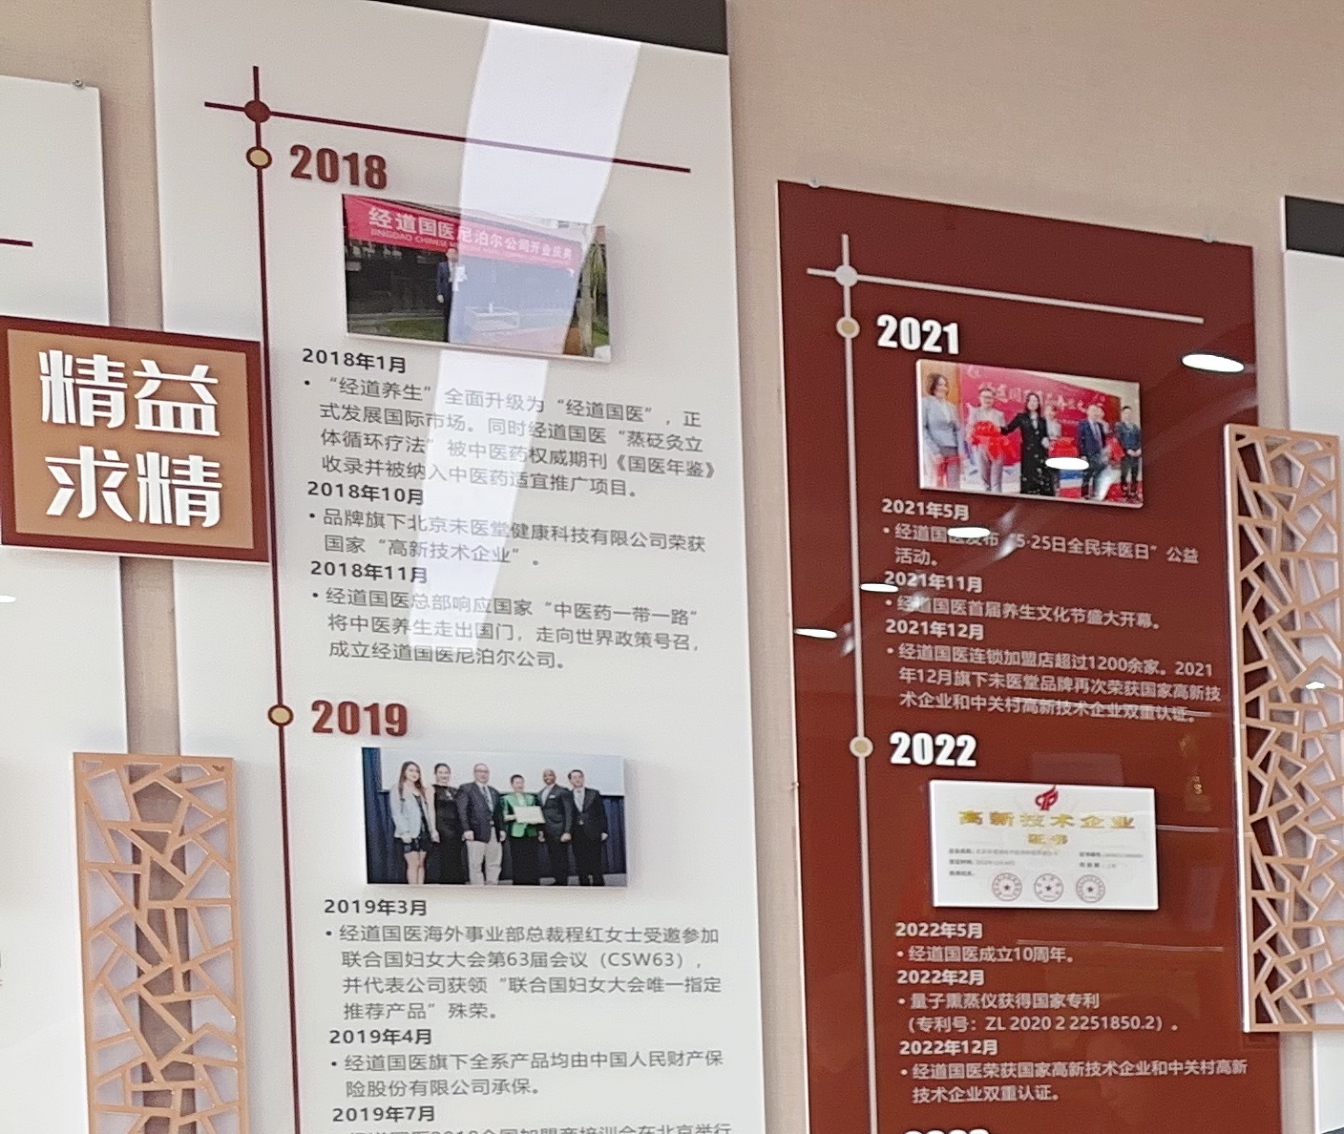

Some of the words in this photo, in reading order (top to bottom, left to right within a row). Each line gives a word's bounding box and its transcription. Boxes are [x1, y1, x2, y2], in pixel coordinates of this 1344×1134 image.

[289, 144, 388, 190] 2018
[876, 314, 960, 355] 2021
[302, 348, 406, 373] 2018年1月
[39, 349, 221, 437] 精益
[45, 446, 223, 528] 求精
[307, 481, 424, 505] 2018年10月
[882, 499, 970, 521] 2021年5月
[895, 547, 938, 567] 活动。
[310, 560, 428, 584] 2018年11月
[884, 571, 983, 594] 2021年11月
[885, 619, 984, 641] 2021年12月
[311, 700, 409, 737] 2019
[889, 732, 977, 767] 2022
[958, 809, 1136, 829] 高新技术企业
[324, 899, 428, 917] 2019年3月
[895, 922, 983, 939] 2022年5月
[908, 946, 1074, 964] 经道国医成立10周年。
[897, 969, 985, 986] 2022年2月
[329, 1028, 432, 1045] 2019年4月
[899, 1039, 998, 1056] 2022年12月
[345, 1078, 540, 1098] 险股份有限公司承保。
[912, 1085, 1060, 1103] 技术企业双重认证。
[332, 1105, 436, 1123] 2019年7月
